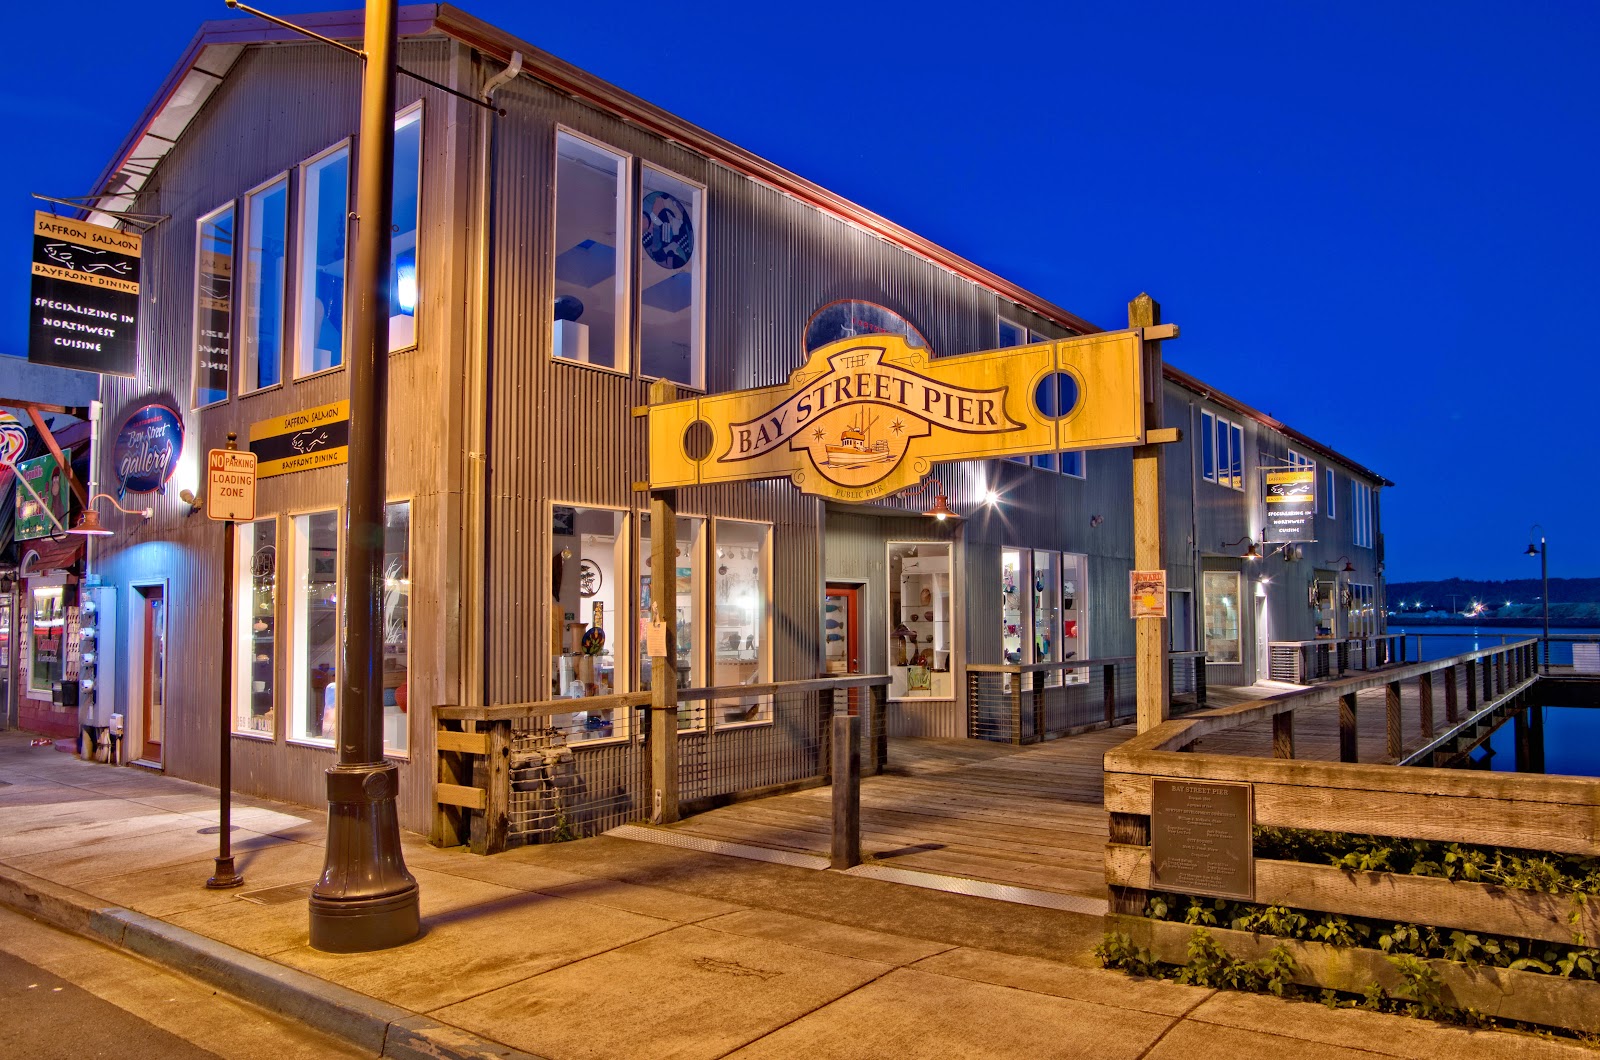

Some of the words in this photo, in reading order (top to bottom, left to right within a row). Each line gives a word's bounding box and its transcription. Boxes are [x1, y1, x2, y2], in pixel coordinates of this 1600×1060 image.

[38, 221, 87, 240] SAFFRON
[92, 233, 138, 251] SALMON
[34, 264, 94, 283] BAYFRONT
[98, 277, 138, 292] DINING
[34, 297, 117, 321] SPECIALIZING
[121, 314, 134, 323] IN
[43, 317, 115, 338] NORTHWEST
[54, 337, 101, 352] CUISINE
[840, 353, 869, 369] THE
[284, 414, 310, 429] SAFFRON
[311, 408, 339, 423] SALMON
[738, 409, 788, 453] BAY
[796, 372, 914, 423] STREET
[922, 385, 998, 426] PIER
[211, 454, 224, 468] NO
[225, 457, 254, 469] PARKING
[282, 457, 313, 470] BAYFRONT
[315, 452, 338, 464] DINING
[213, 474, 252, 485] LOADING
[220, 487, 244, 498] ZONE
[836, 489, 863, 499] PUBLIC
[866, 485, 884, 497] PIER
[1212, 788, 1229, 796] PIER
